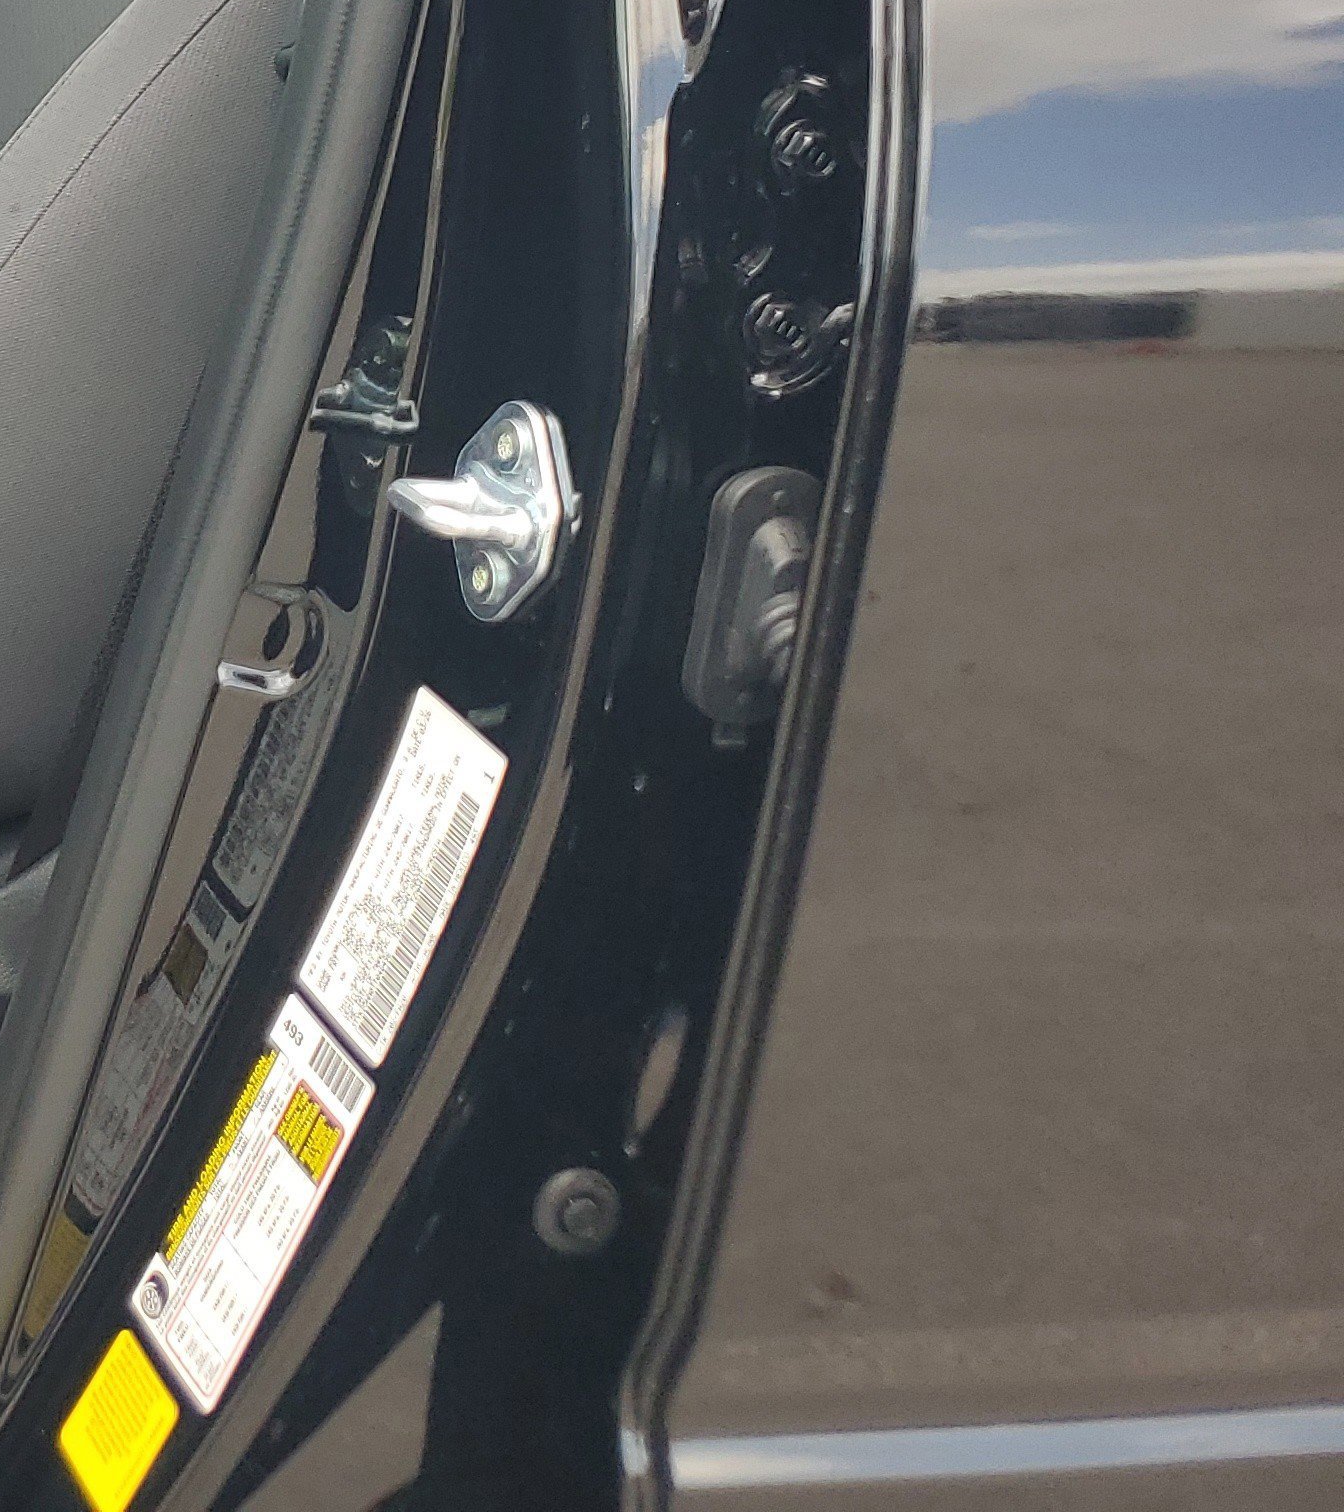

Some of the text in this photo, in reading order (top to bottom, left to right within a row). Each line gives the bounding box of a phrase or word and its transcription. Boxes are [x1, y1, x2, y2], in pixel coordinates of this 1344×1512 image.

[282, 1017, 305, 1048] 493
[168, 1213, 184, 1241] TIRE
[182, 1187, 198, 1215] AND
[196, 1135, 225, 1189] LOADING
[223, 1054, 266, 1136] INFORMATION
